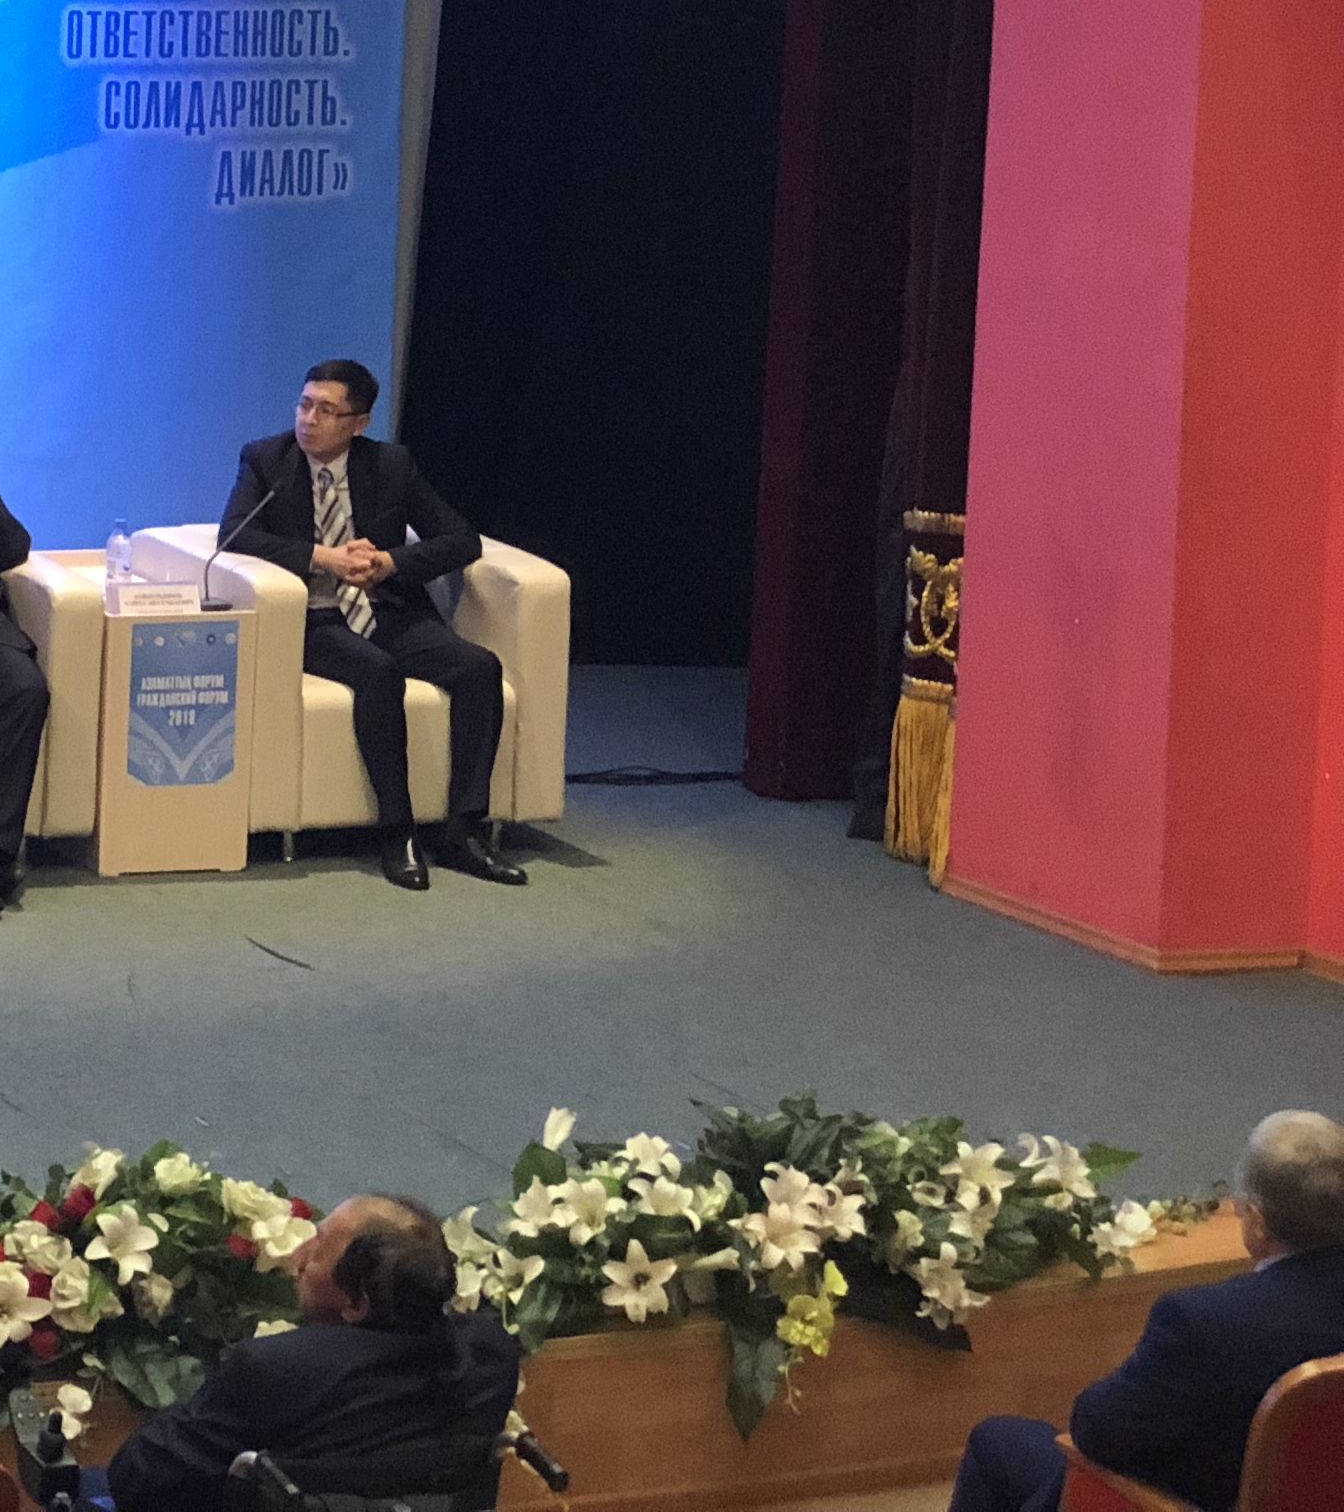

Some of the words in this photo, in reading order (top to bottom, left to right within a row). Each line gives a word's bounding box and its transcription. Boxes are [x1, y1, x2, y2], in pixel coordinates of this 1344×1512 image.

[66, 9, 351, 60] ОТВЕТСТВЕННОСТЬ.
[104, 78, 347, 136] СОЛИДАРНОСТЬ.
[214, 148, 348, 205] ДИАЛОГ»
